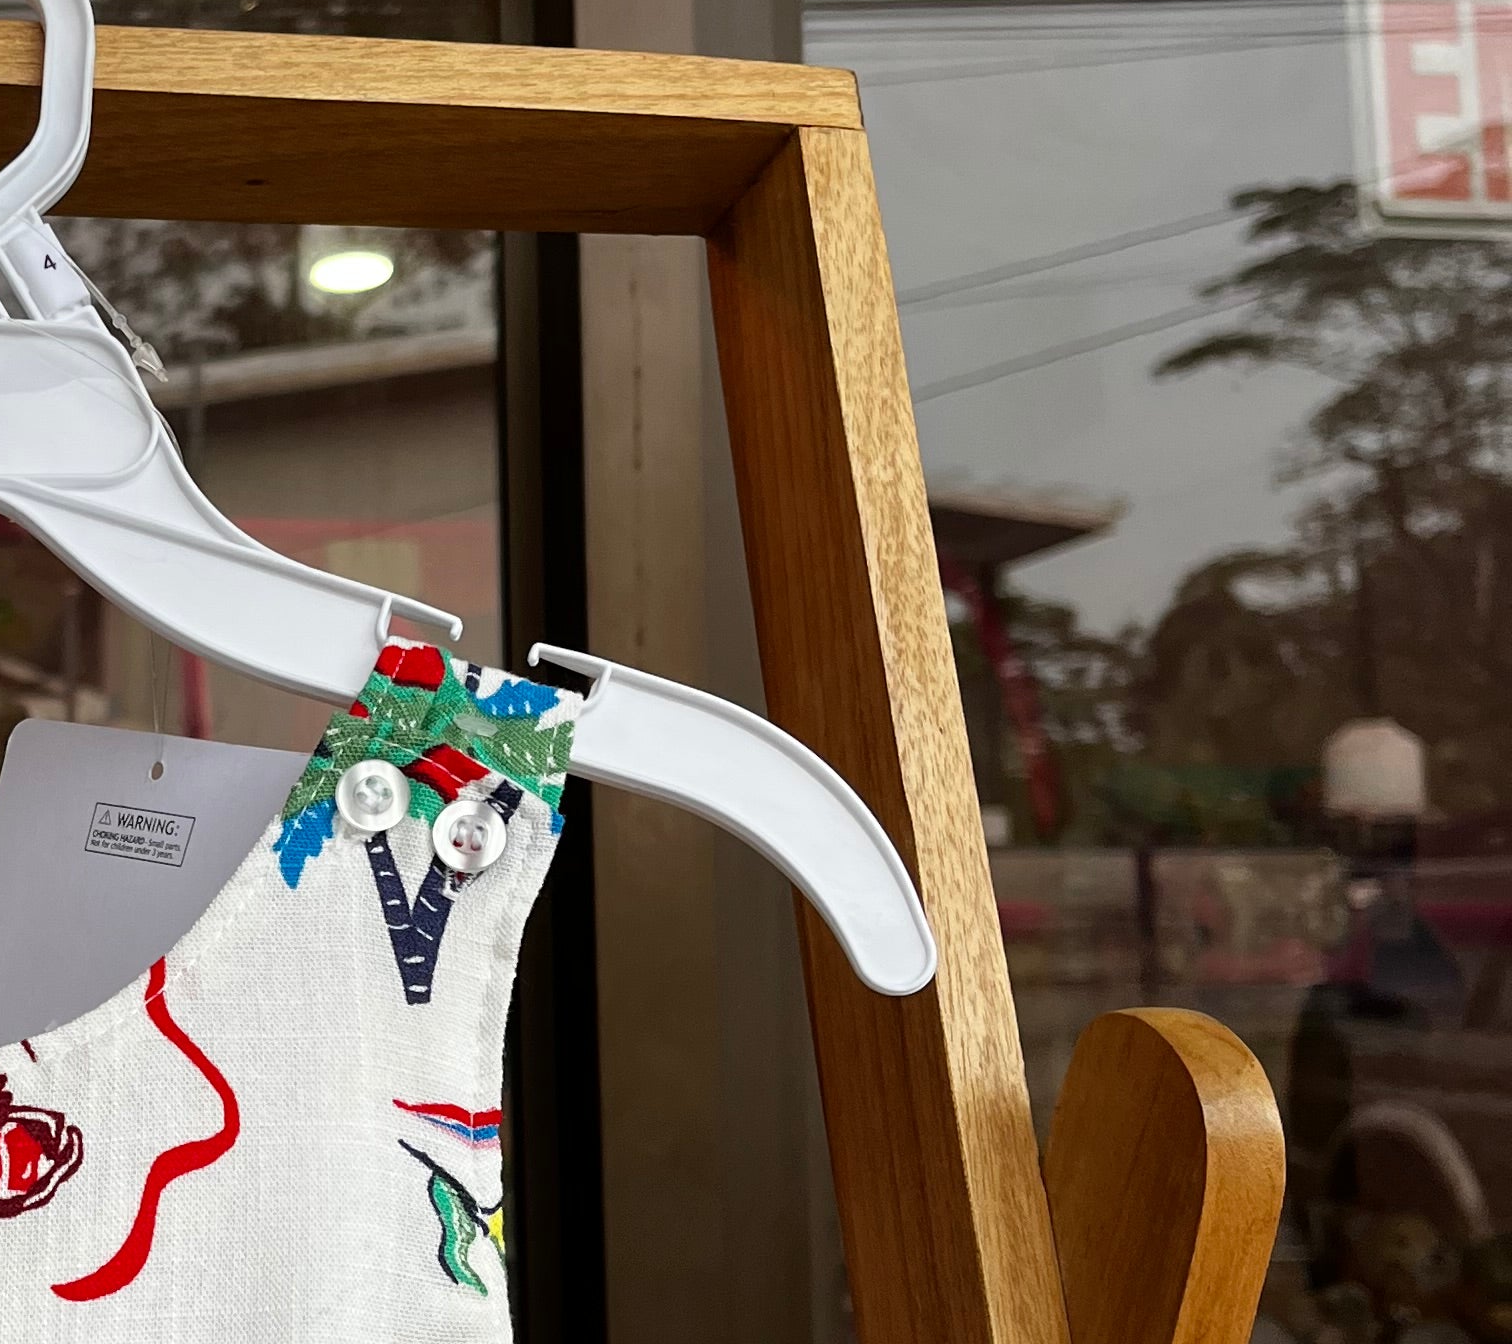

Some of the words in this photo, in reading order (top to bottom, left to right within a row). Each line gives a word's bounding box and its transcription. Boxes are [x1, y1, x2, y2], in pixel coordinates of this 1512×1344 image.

[44, 253, 57, 270] 4
[117, 811, 180, 837] WARNING:
[92, 829, 120, 841] CHOKING
